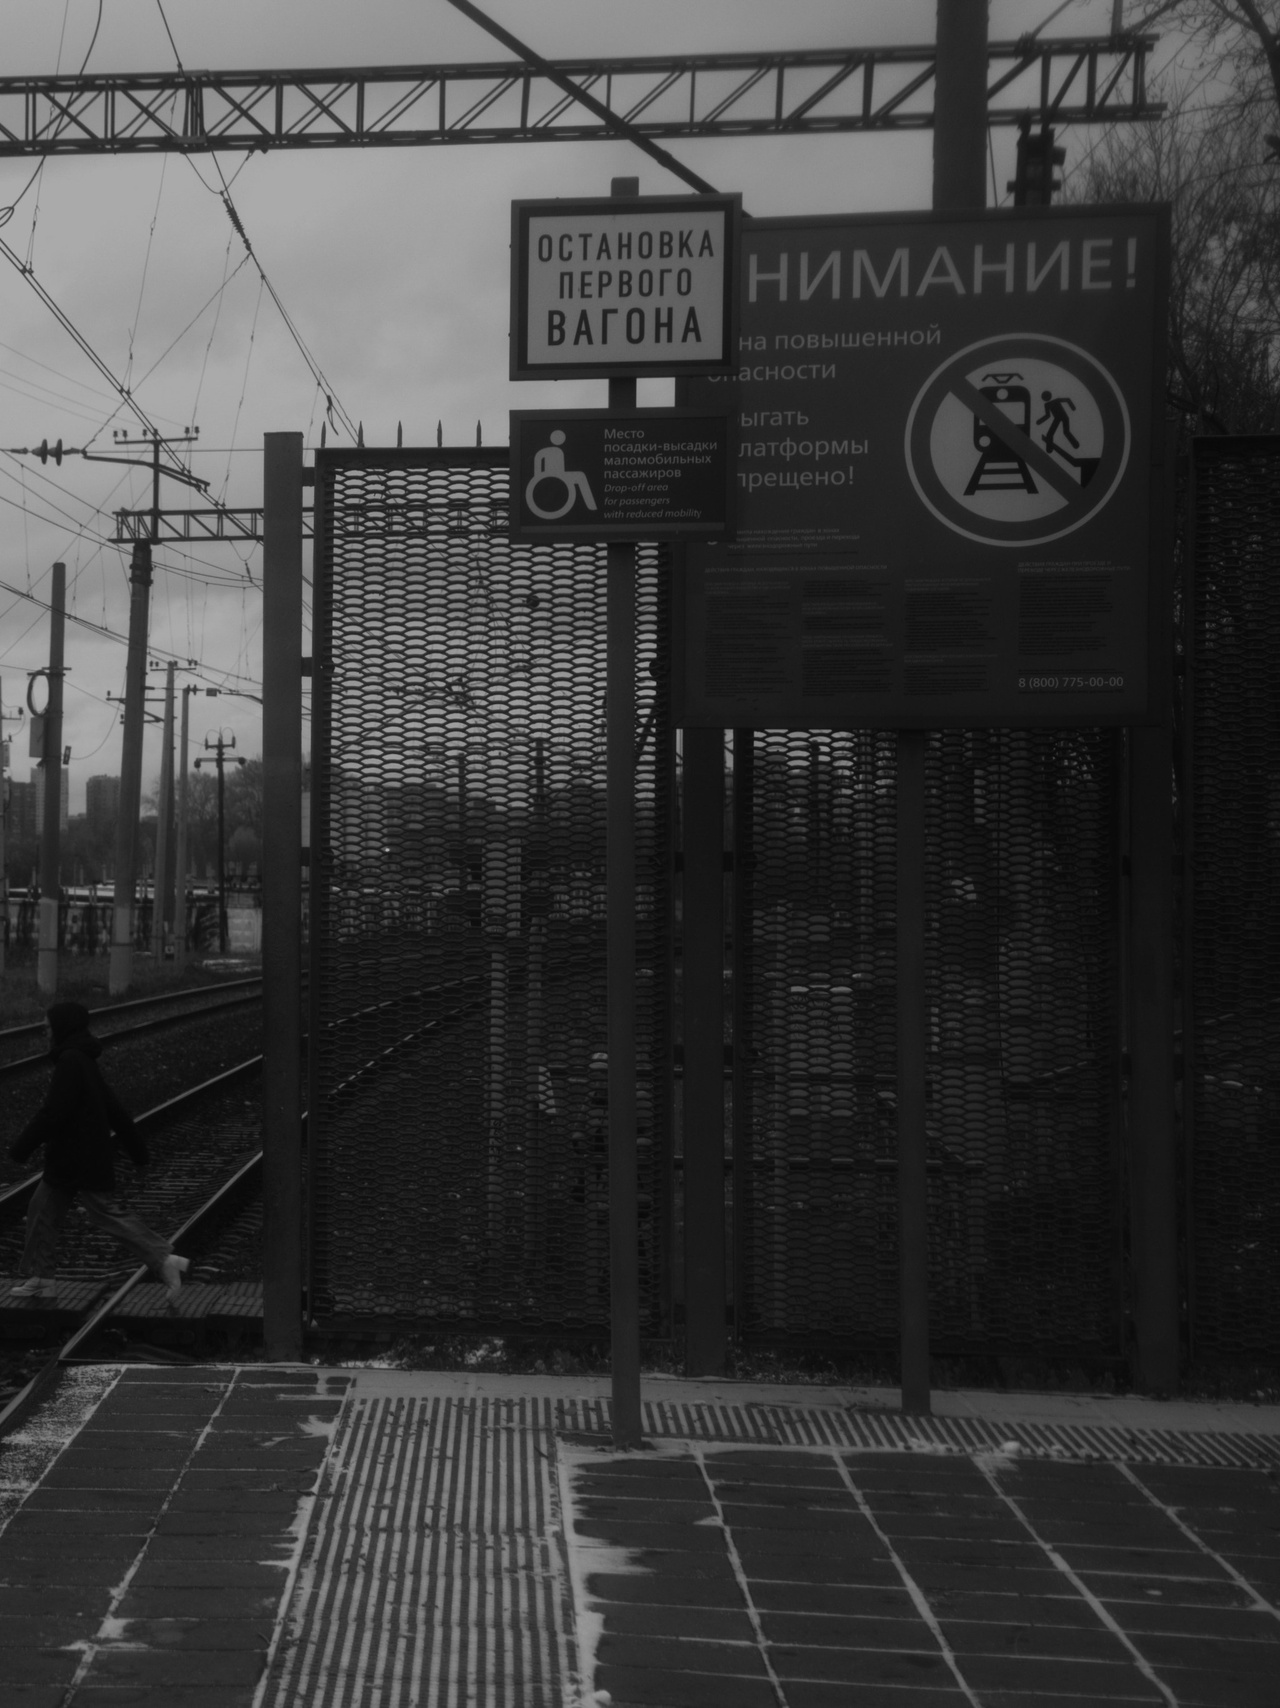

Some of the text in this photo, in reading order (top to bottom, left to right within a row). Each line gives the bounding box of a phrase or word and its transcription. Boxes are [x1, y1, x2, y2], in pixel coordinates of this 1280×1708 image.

[537, 229, 715, 263] ОСТАНОВКА
[748, 237, 1137, 303] НИМАНИЕ!
[558, 268, 693, 299] ПЕРВОГО
[547, 306, 703, 347] ВАГОНА
[775, 323, 942, 351] повышенной
[737, 411, 810, 428] ыгать
[603, 428, 646, 440] Место
[603, 441, 719, 454] посадки-высадки
[738, 436, 870, 462] латформы
[603, 453, 713, 466] маломобильных
[603, 469, 682, 481] пассажиров
[603, 483, 669, 494] Drop-off area
[604, 497, 671, 507] for passengers
[603, 508, 703, 519] with reduced mobility
[1018, 676, 1124, 689] 8 (800) 775-00-00
